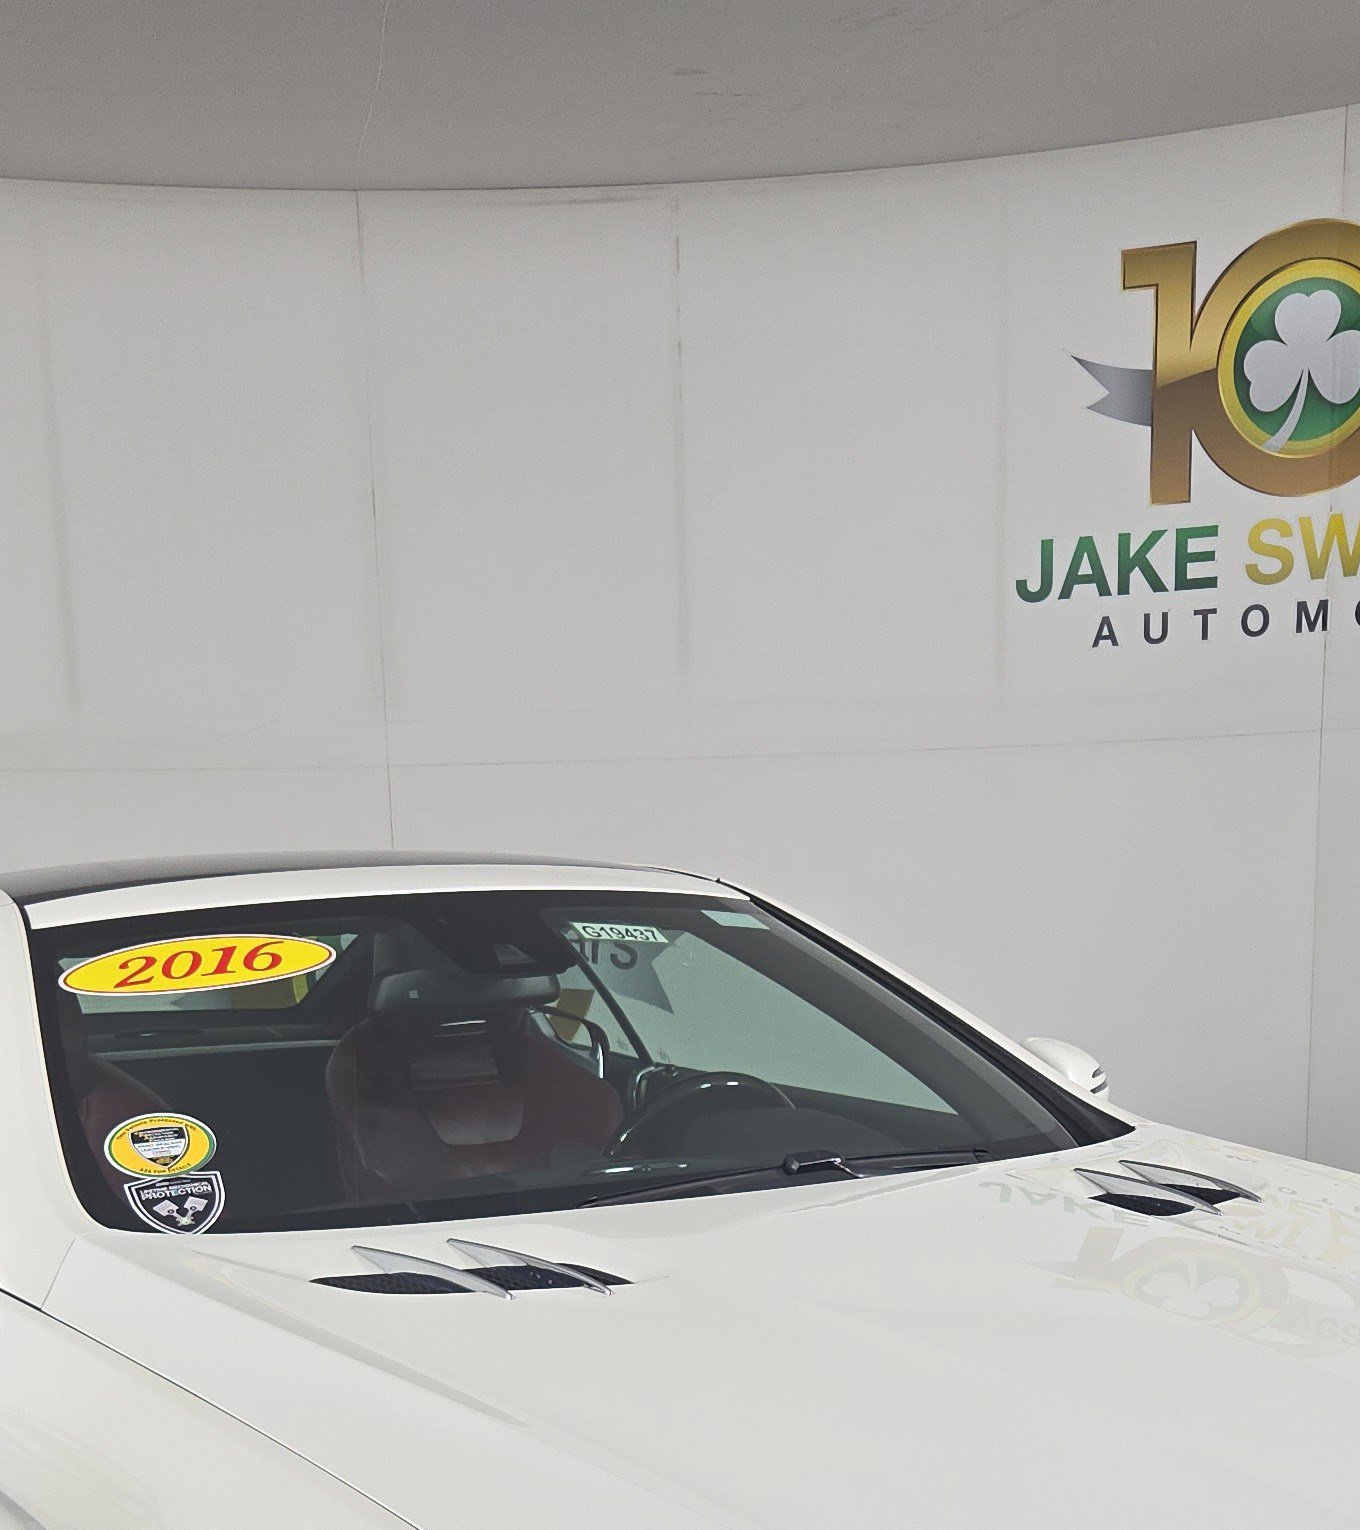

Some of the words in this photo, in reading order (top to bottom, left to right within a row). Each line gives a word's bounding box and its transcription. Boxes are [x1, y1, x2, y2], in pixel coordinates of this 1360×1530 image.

[1015, 524, 1220, 604] JAKE
[581, 925, 658, 941] G19437
[113, 941, 284, 988] 2016
[141, 1184, 213, 1201] PROTECTION
